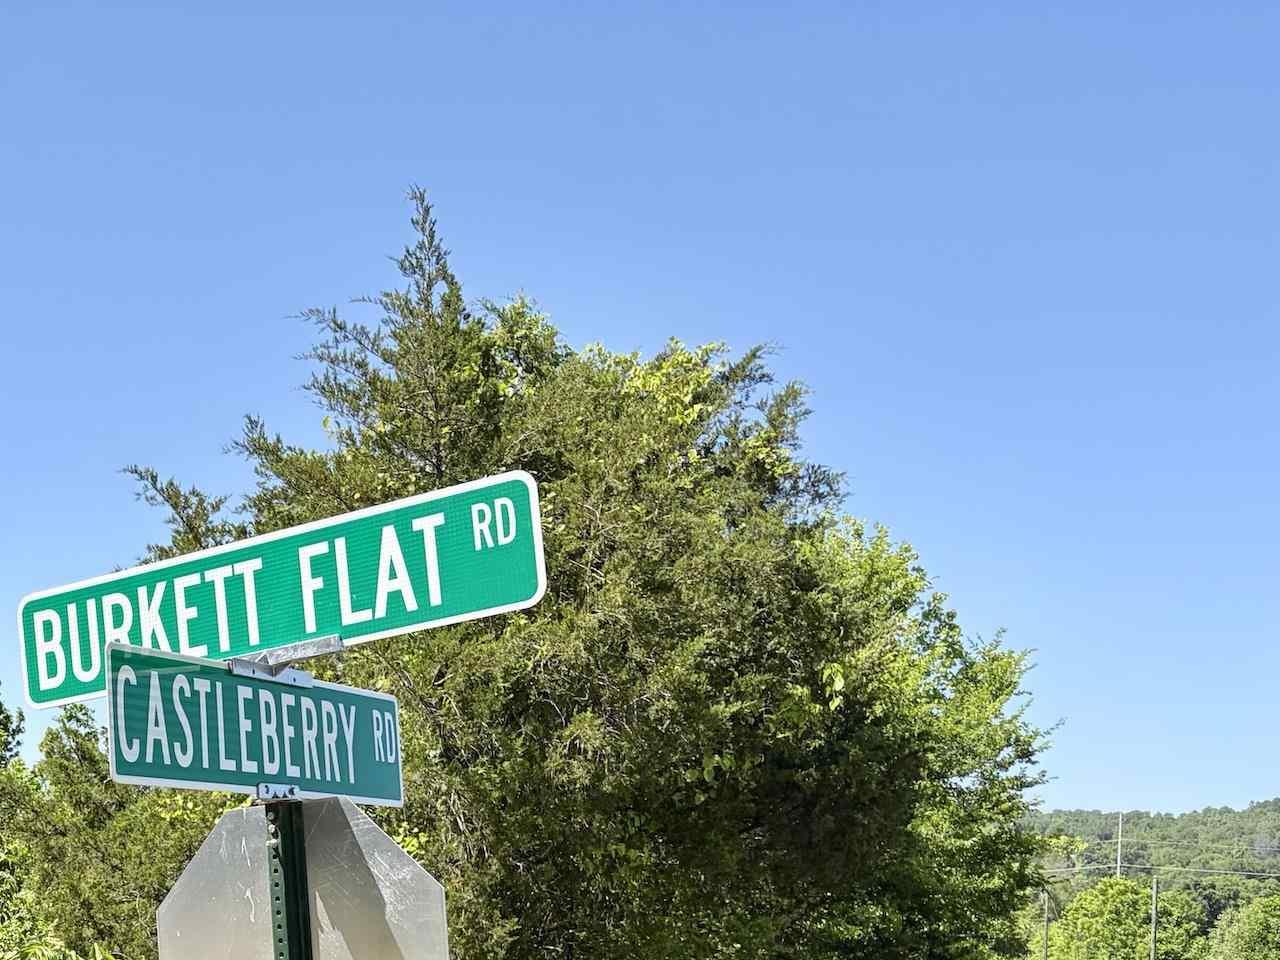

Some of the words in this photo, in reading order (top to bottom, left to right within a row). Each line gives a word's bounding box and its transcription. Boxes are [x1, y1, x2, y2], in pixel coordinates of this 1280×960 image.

[33, 558, 263, 691] BURKETT
[298, 512, 445, 633] FLAT
[471, 496, 517, 551] RD
[116, 665, 356, 785] CASTLEBERRY
[371, 709, 396, 764] RD
